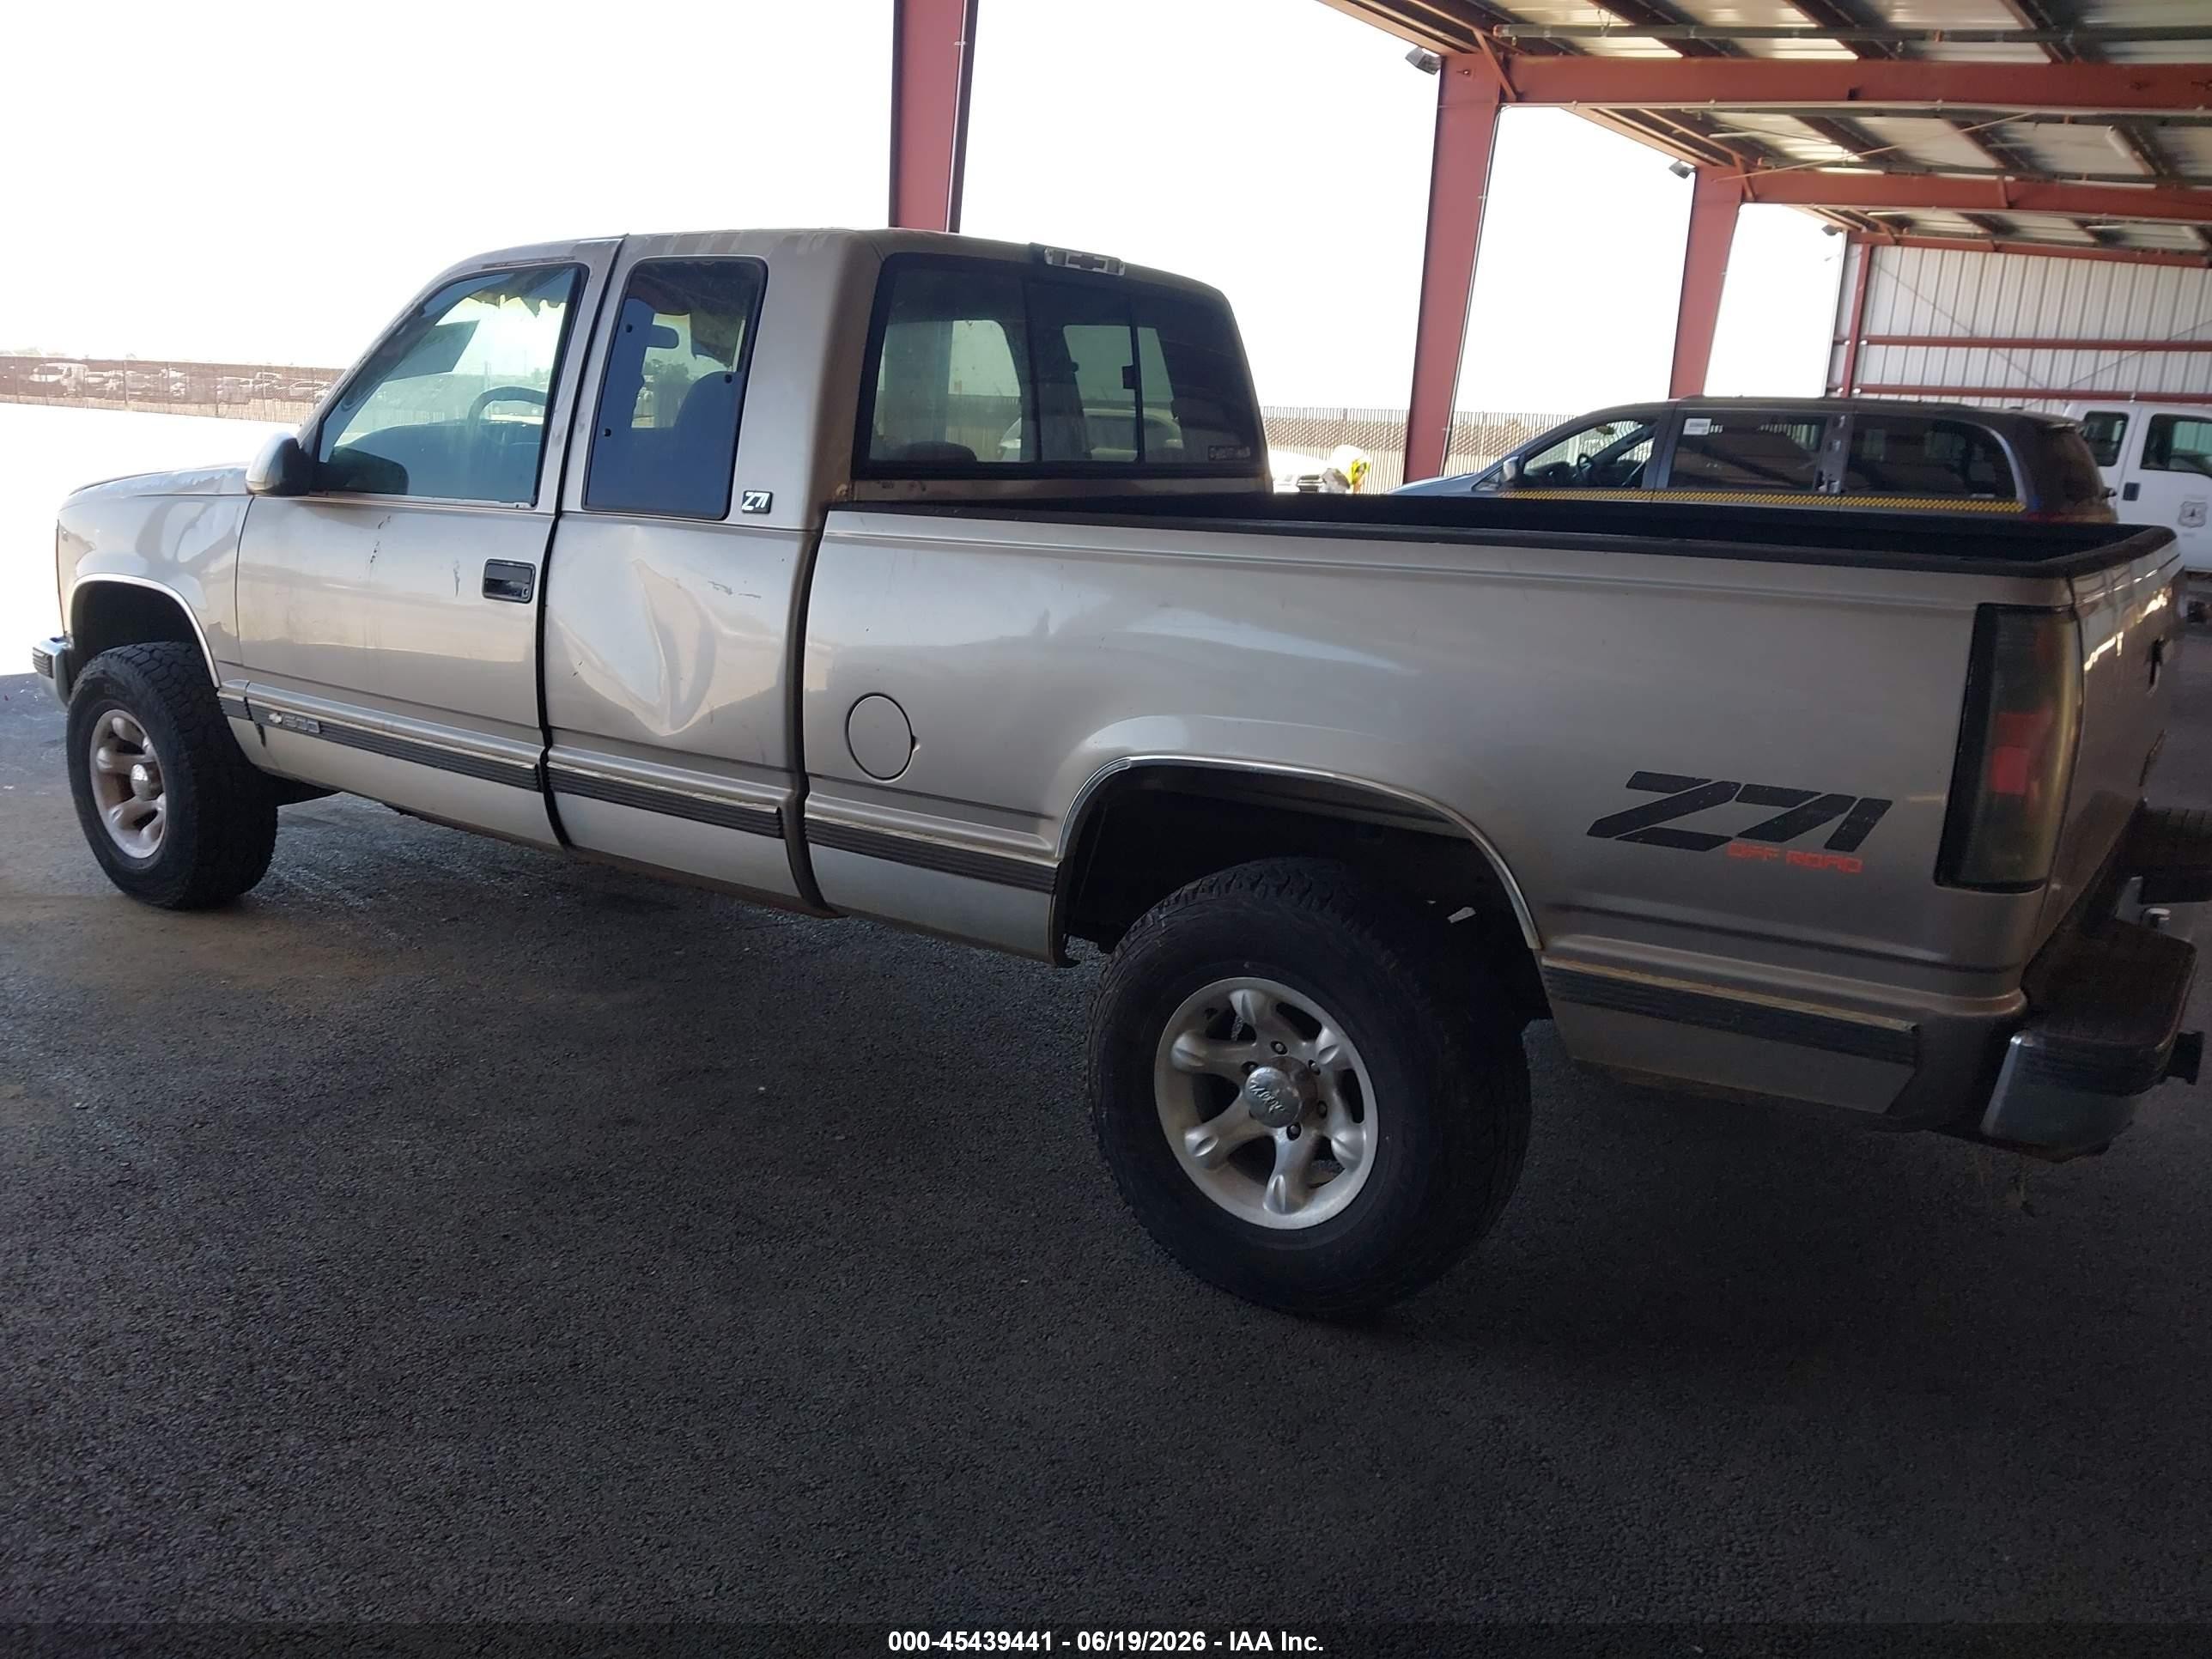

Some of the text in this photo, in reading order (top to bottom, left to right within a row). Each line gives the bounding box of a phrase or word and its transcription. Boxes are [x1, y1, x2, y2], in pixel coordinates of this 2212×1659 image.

[742, 491, 770, 511] Z71
[1587, 770, 1893, 853] Z71
[1727, 842, 1863, 873] OFF ROAD
